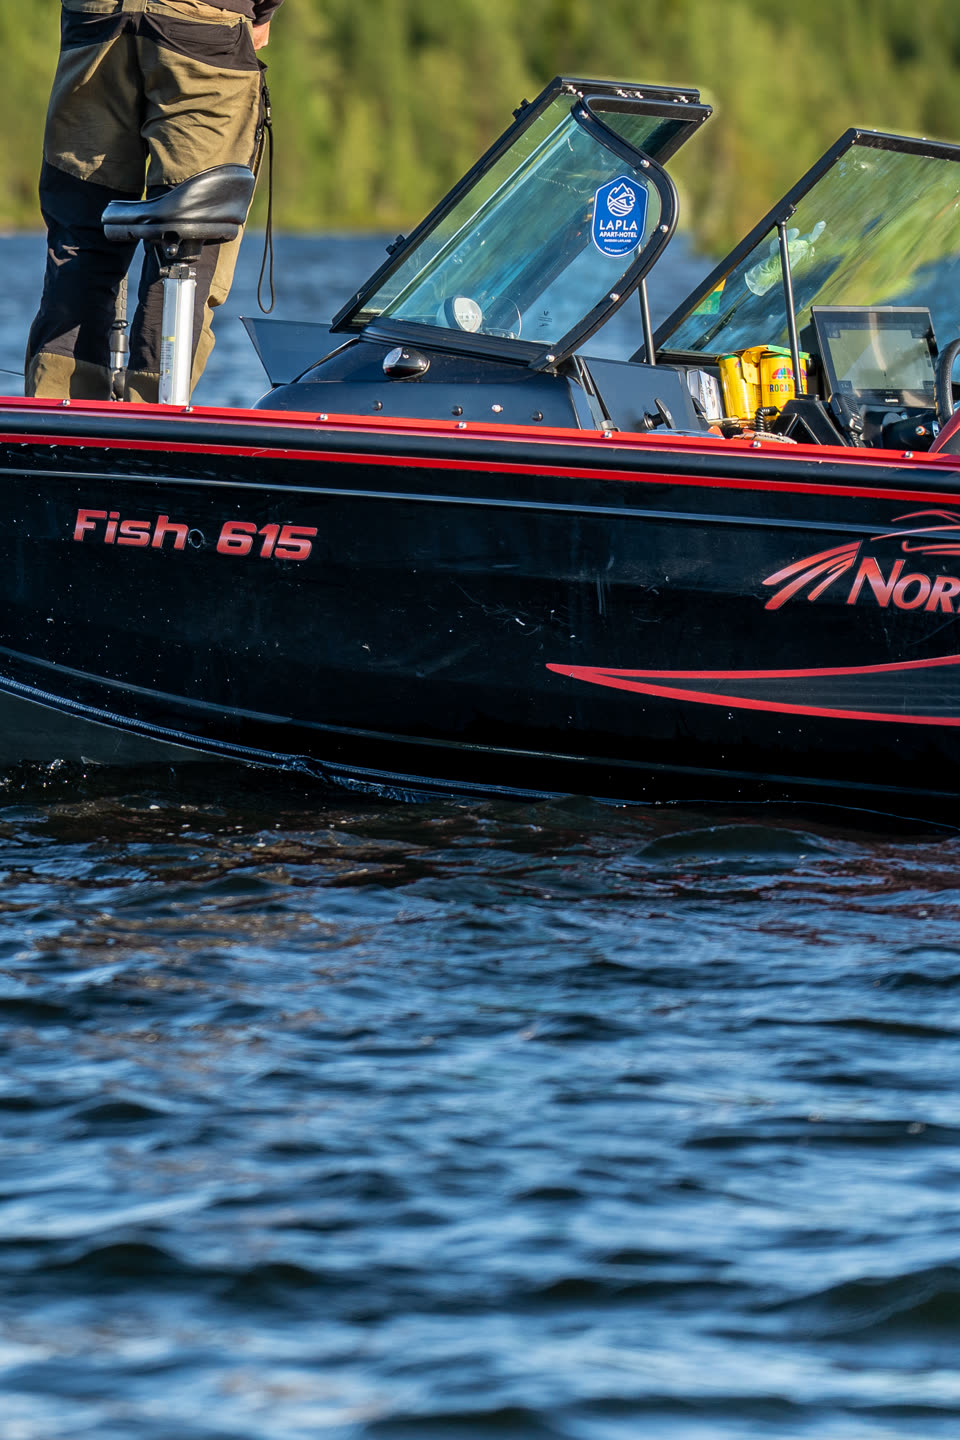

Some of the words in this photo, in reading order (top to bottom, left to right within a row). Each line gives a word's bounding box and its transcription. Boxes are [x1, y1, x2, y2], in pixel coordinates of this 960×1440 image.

[599, 219, 638, 230] LAPLA
[73, 508, 189, 550] Fish
[216, 520, 318, 561] 615
[846, 556, 960, 613] NOR
